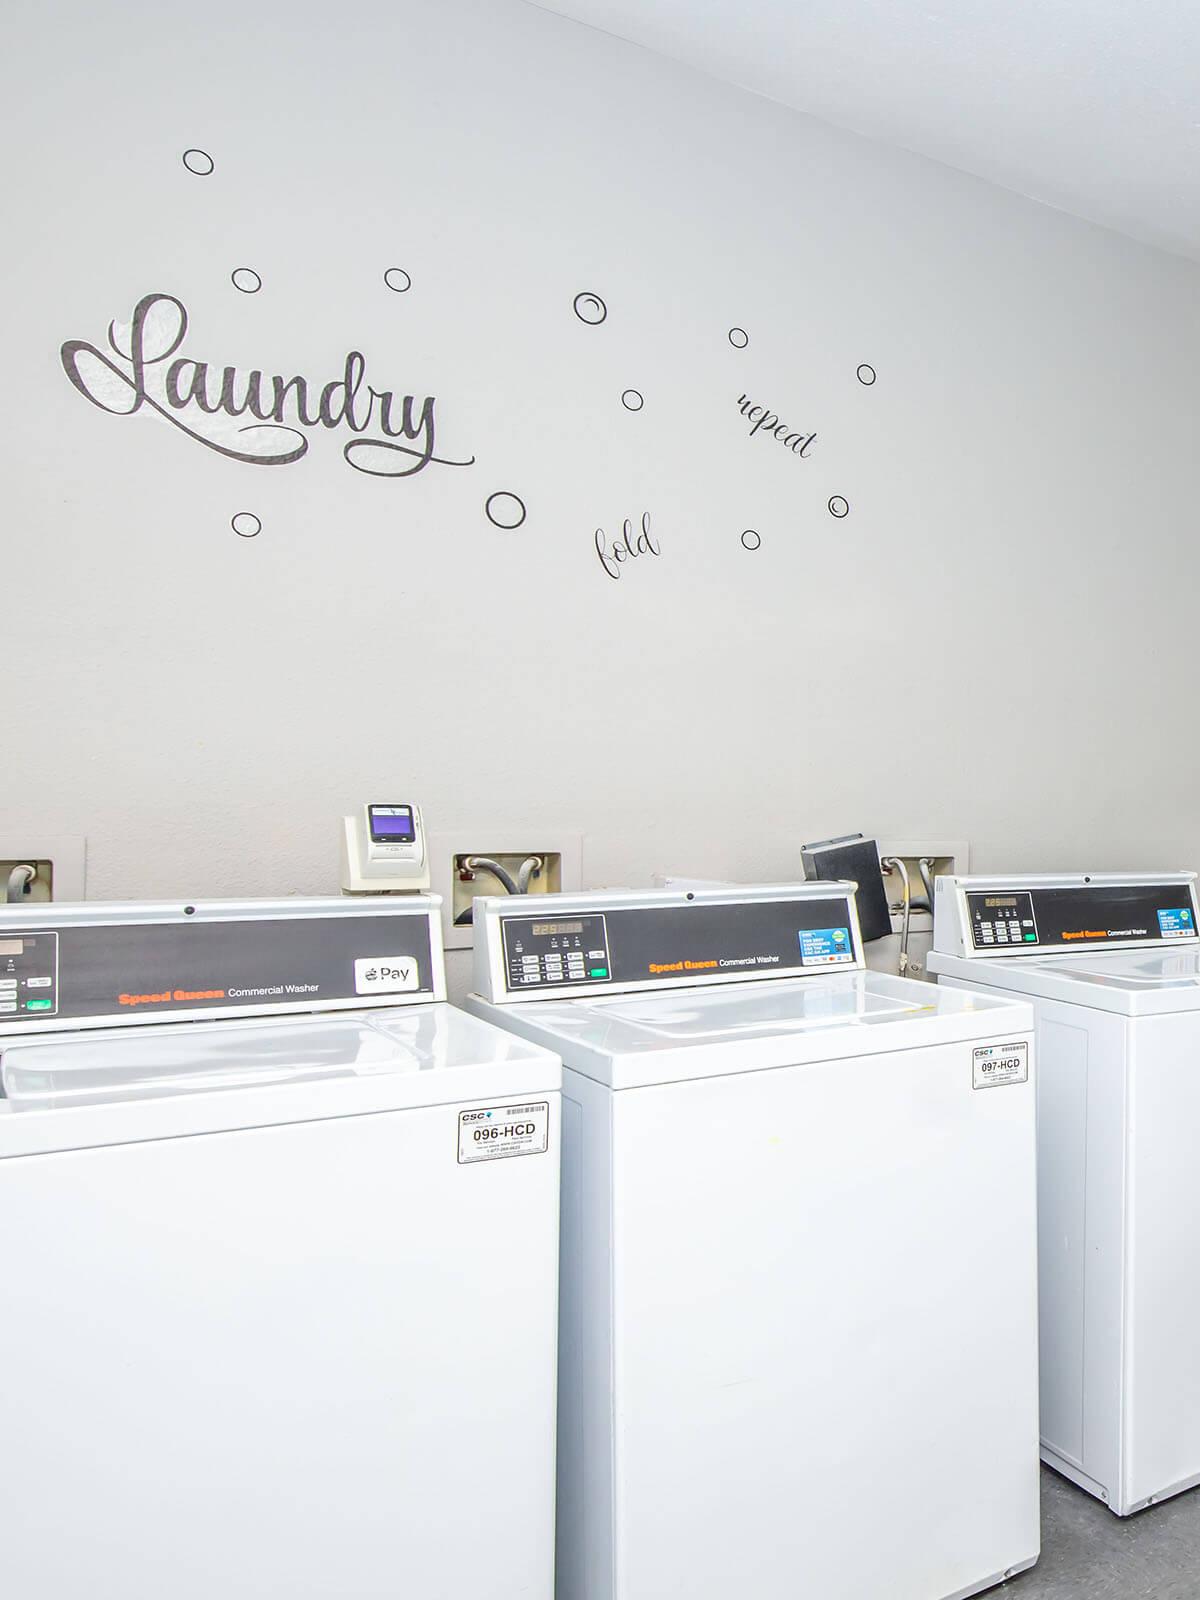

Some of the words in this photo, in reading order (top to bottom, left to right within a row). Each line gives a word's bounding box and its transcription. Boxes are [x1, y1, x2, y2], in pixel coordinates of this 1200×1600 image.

[61, 293, 475, 477] Laundry
[737, 394, 817, 458] repeat
[595, 511, 660, 579] fold
[649, 961, 683, 974] Speed
[684, 960, 717, 969] Queen
[719, 957, 756, 967] Commercial
[756, 955, 780, 963] Washer
[381, 967, 409, 981] Pay
[118, 991, 171, 1006] Speed
[173, 989, 224, 1001] Queen
[228, 985, 284, 997] Commercial
[285, 983, 320, 993] Washer
[974, 1049, 988, 1057] CSC
[981, 1058, 1020, 1073] 097-HCD
[462, 1112, 485, 1121] CSC
[473, 1123, 536, 1141] 096-HCD
